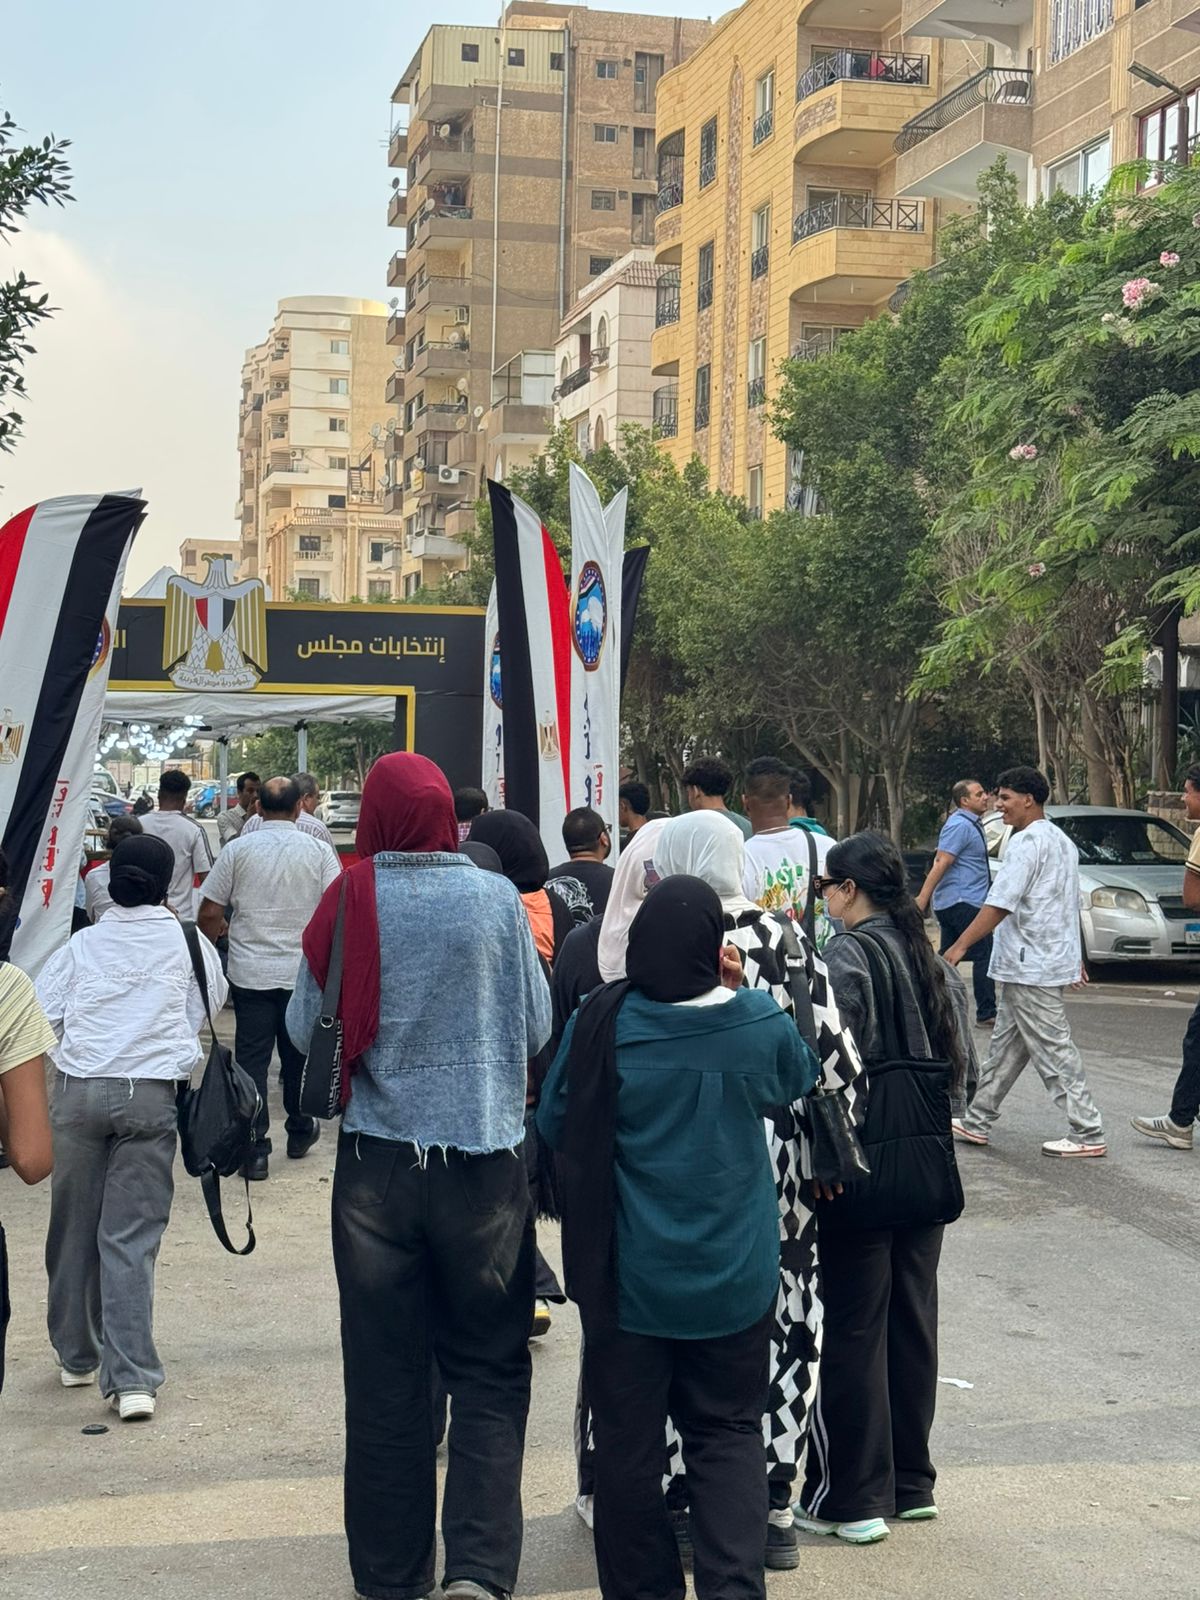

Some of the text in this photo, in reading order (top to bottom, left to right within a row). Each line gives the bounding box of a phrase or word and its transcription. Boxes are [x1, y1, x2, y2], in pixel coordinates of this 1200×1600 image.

[297, 634, 446, 663] إنتخابات مجلس
[39, 825, 60, 872] مدينة
